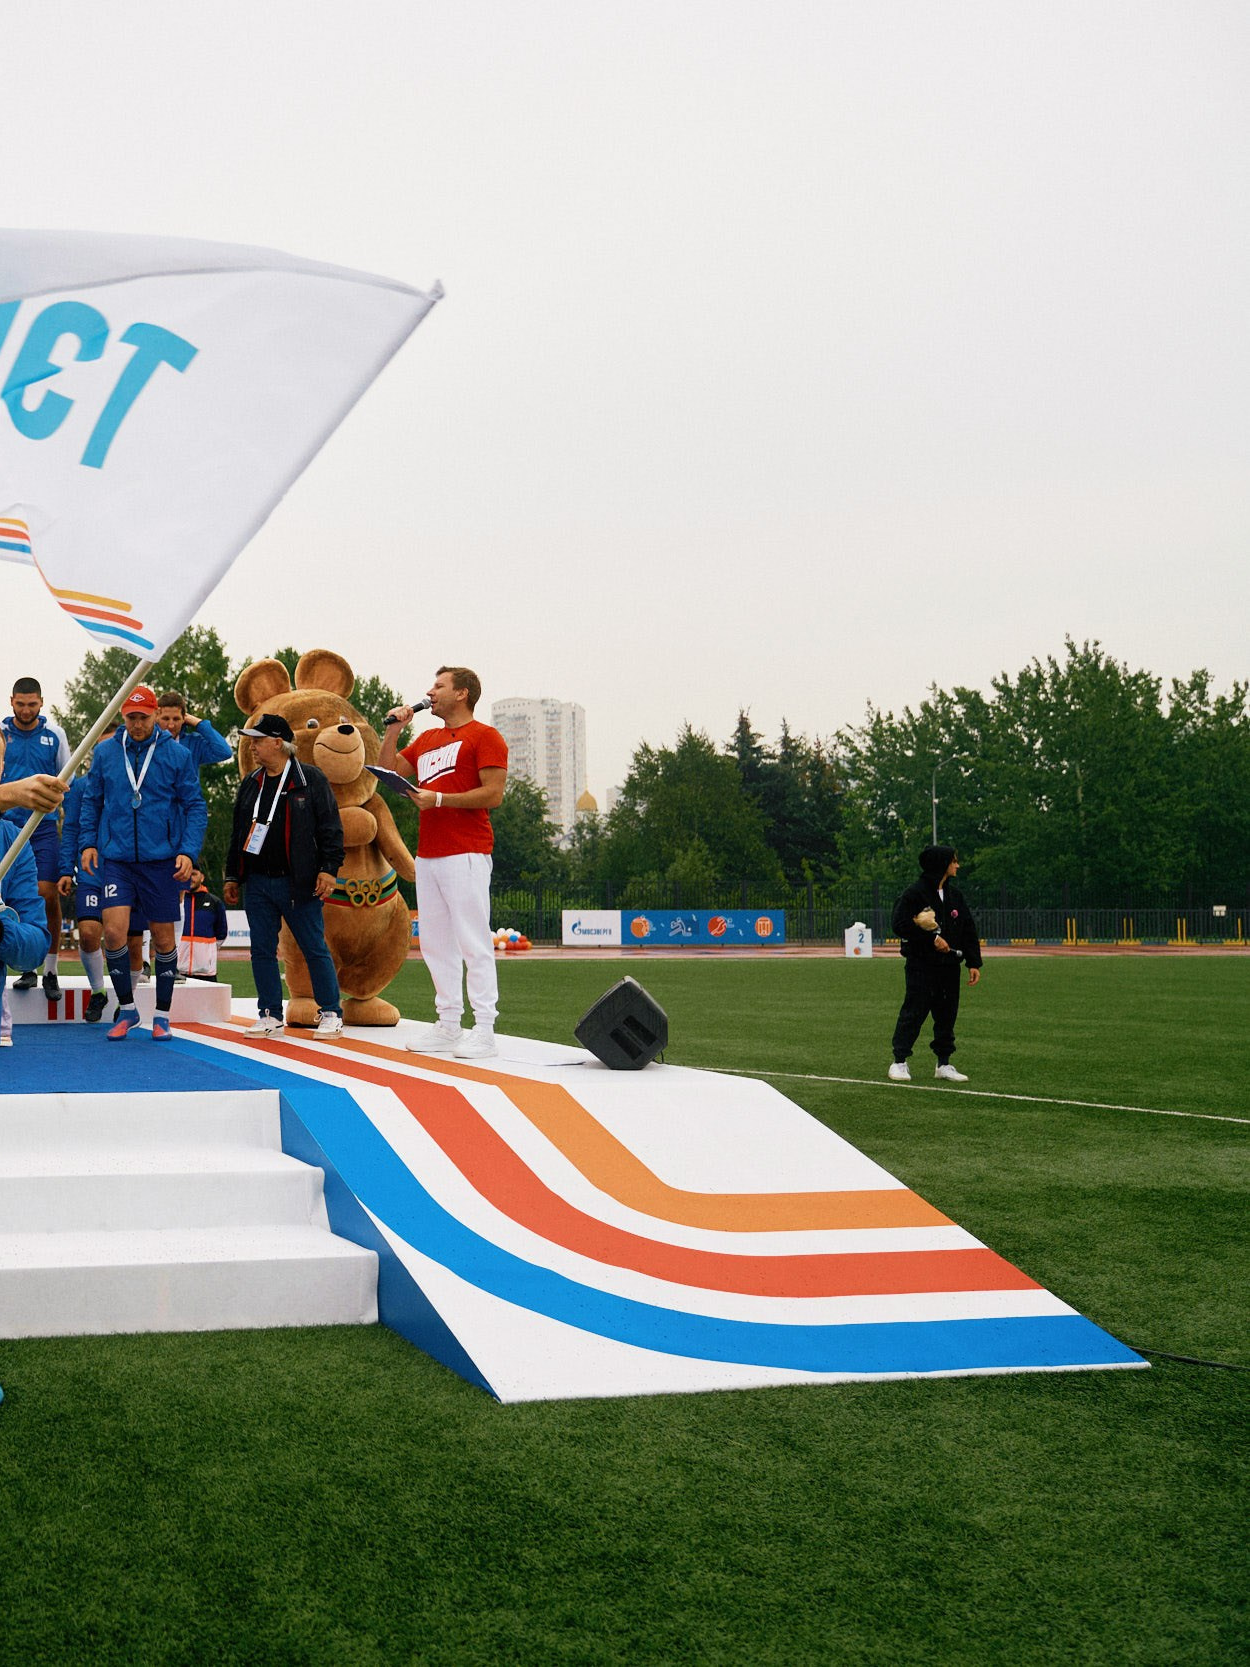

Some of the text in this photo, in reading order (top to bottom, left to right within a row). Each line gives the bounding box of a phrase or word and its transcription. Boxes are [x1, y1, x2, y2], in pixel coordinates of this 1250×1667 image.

[104, 883, 118, 898] 12
[85, 894, 98, 907] 19
[858, 933, 865, 943] 2
